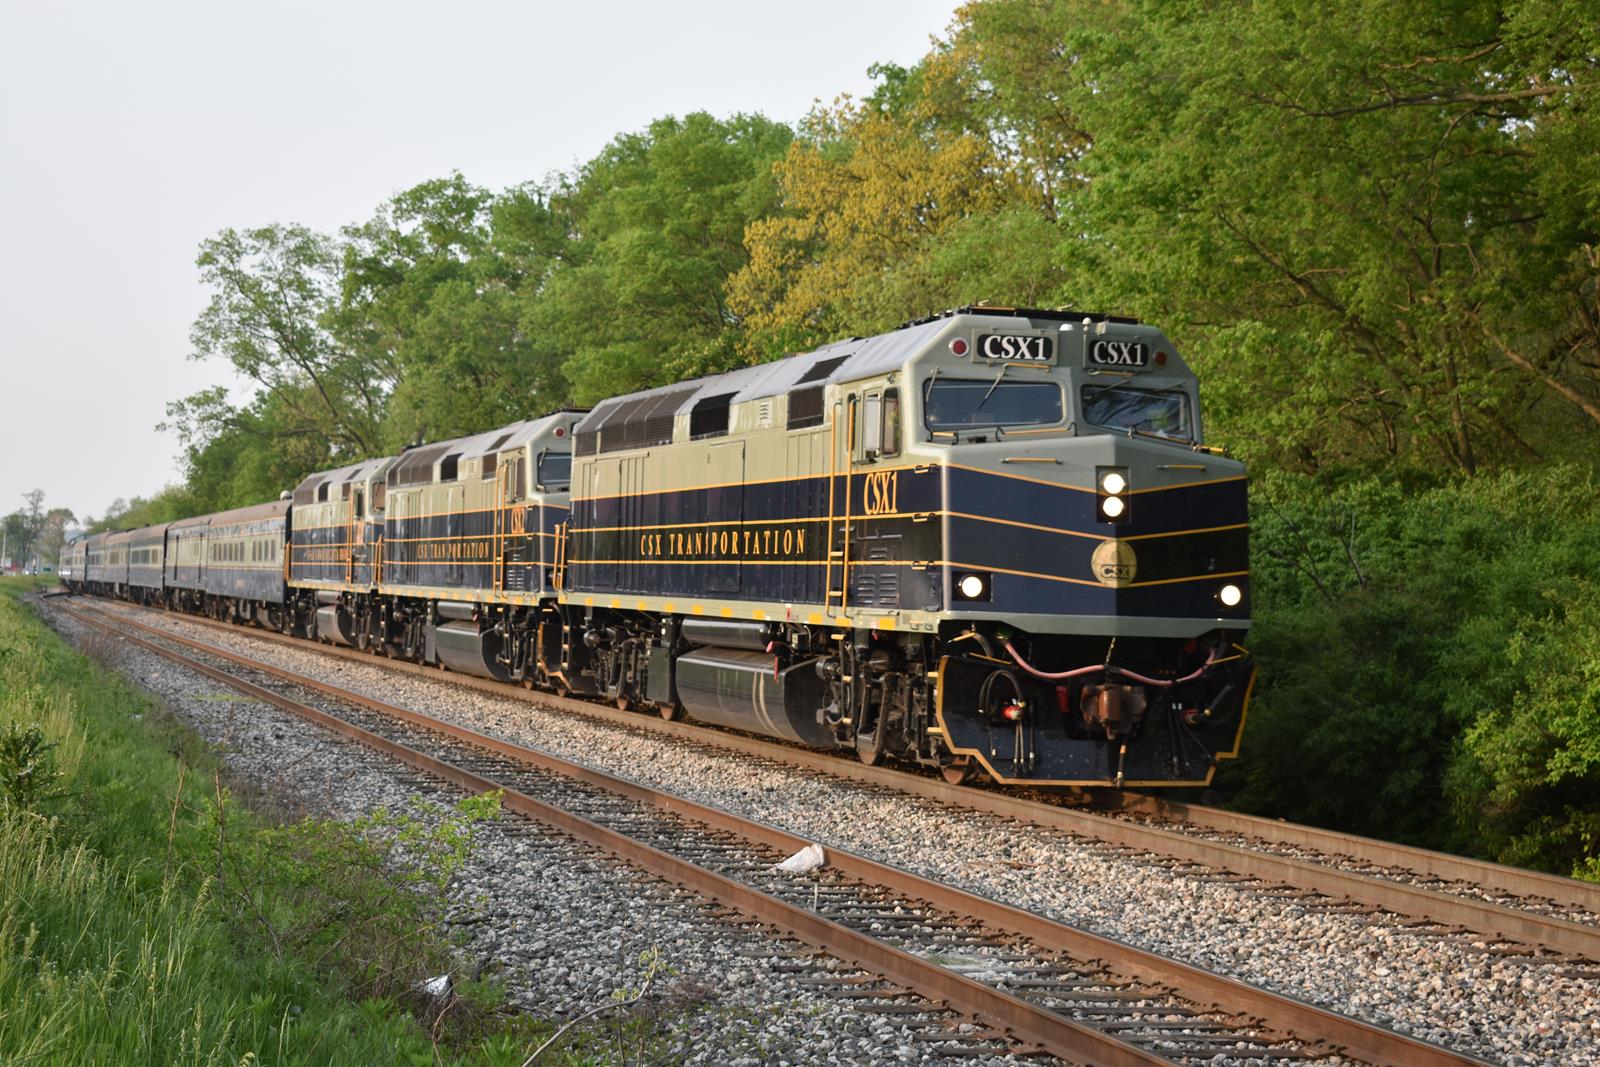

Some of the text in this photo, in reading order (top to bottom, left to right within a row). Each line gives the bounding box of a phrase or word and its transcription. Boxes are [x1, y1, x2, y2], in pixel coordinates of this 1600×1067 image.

[984, 335, 1047, 361] CSX1
[1093, 340, 1144, 366] CSX1
[863, 471, 898, 515] CSX1
[640, 534, 662, 556] CSX
